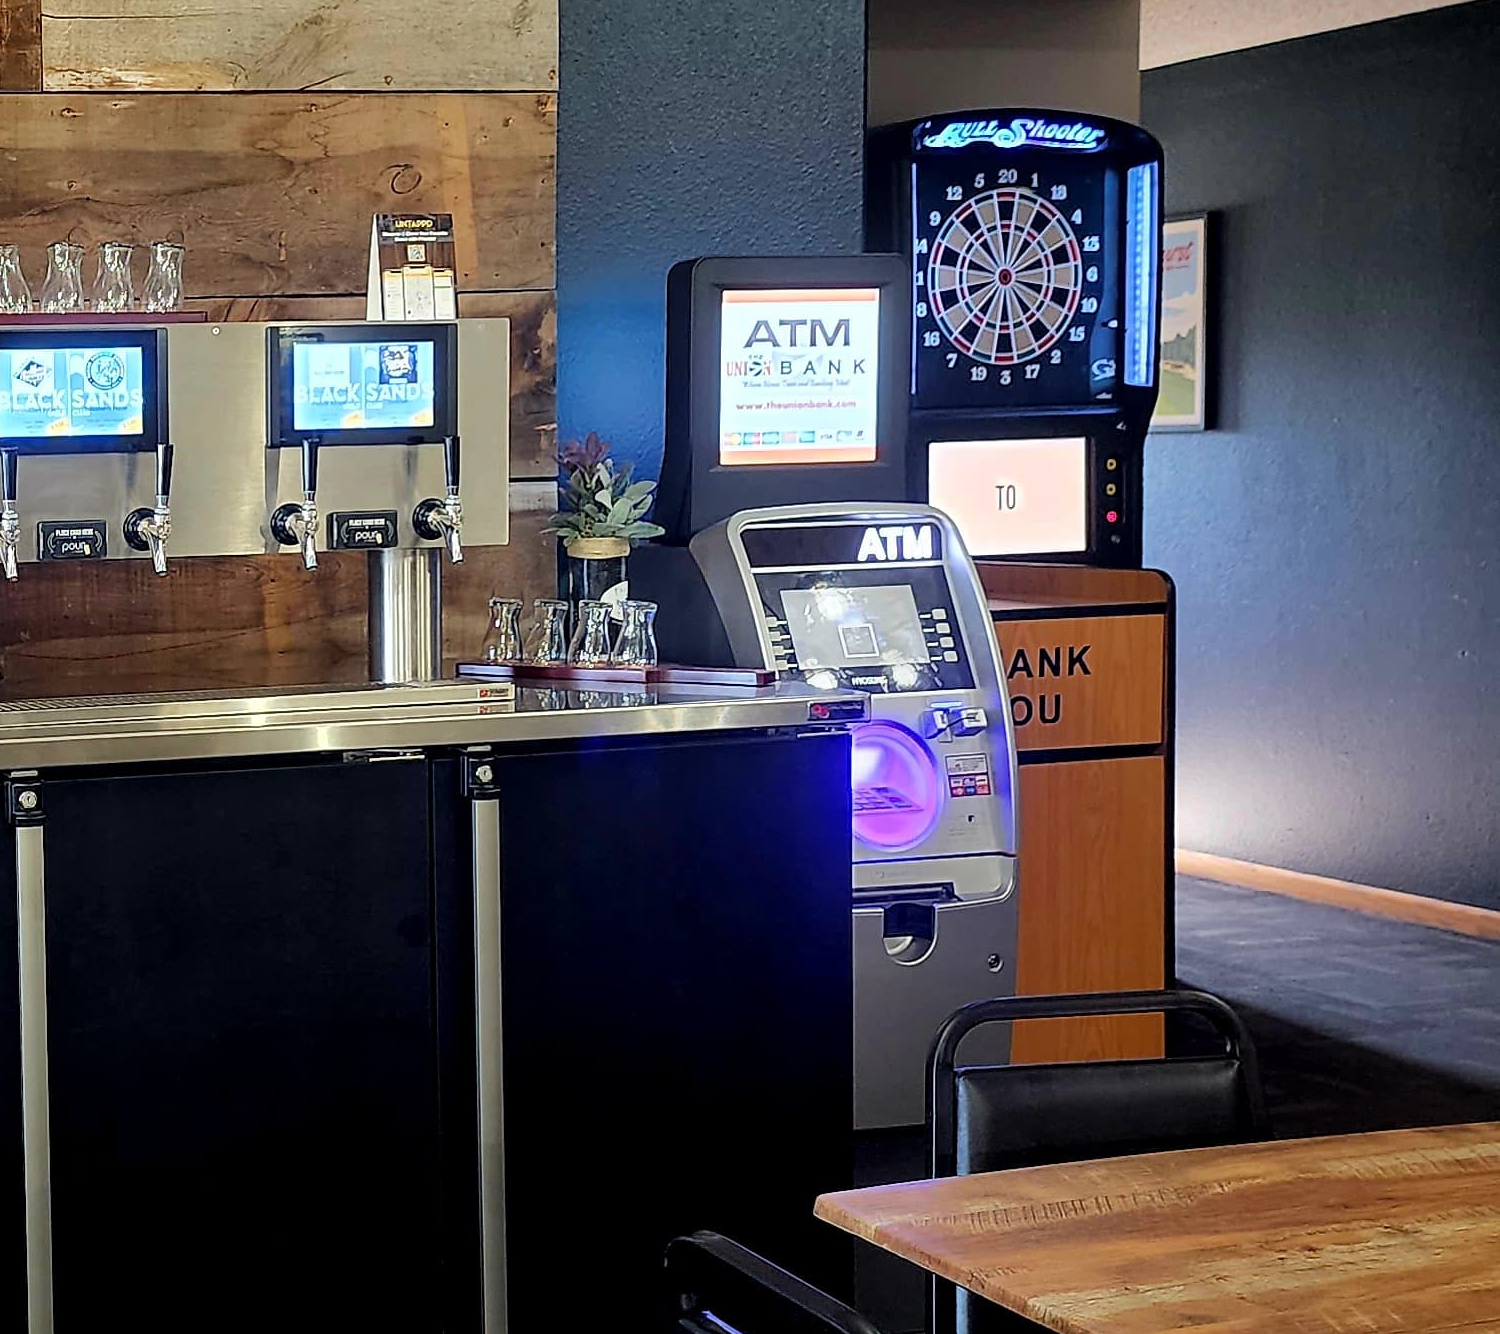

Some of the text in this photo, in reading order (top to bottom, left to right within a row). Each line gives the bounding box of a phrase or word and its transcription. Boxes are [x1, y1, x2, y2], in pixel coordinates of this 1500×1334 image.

[974, 173, 985, 189] 5
[998, 169, 1018, 184] 20
[1031, 172, 1039, 188] 1
[946, 186, 963, 201] 12
[929, 210, 942, 227] 9
[1071, 209, 1082, 225] 4
[1081, 297, 1098, 313] 10
[742, 318, 851, 349] ATM
[1068, 326, 1085, 342] 15
[945, 352, 958, 369] 7
[1050, 349, 1062, 365] 2
[779, 358, 867, 376] BANK
[970, 366, 988, 382] 19
[1024, 364, 1041, 380] 17
[71, 387, 143, 409] SANDS
[366, 382, 435, 403] SANDS
[995, 484, 1016, 511] TO
[857, 524, 934, 562] ATM
[1002, 645, 1092, 680] ANK
[1009, 693, 1061, 727] OU
